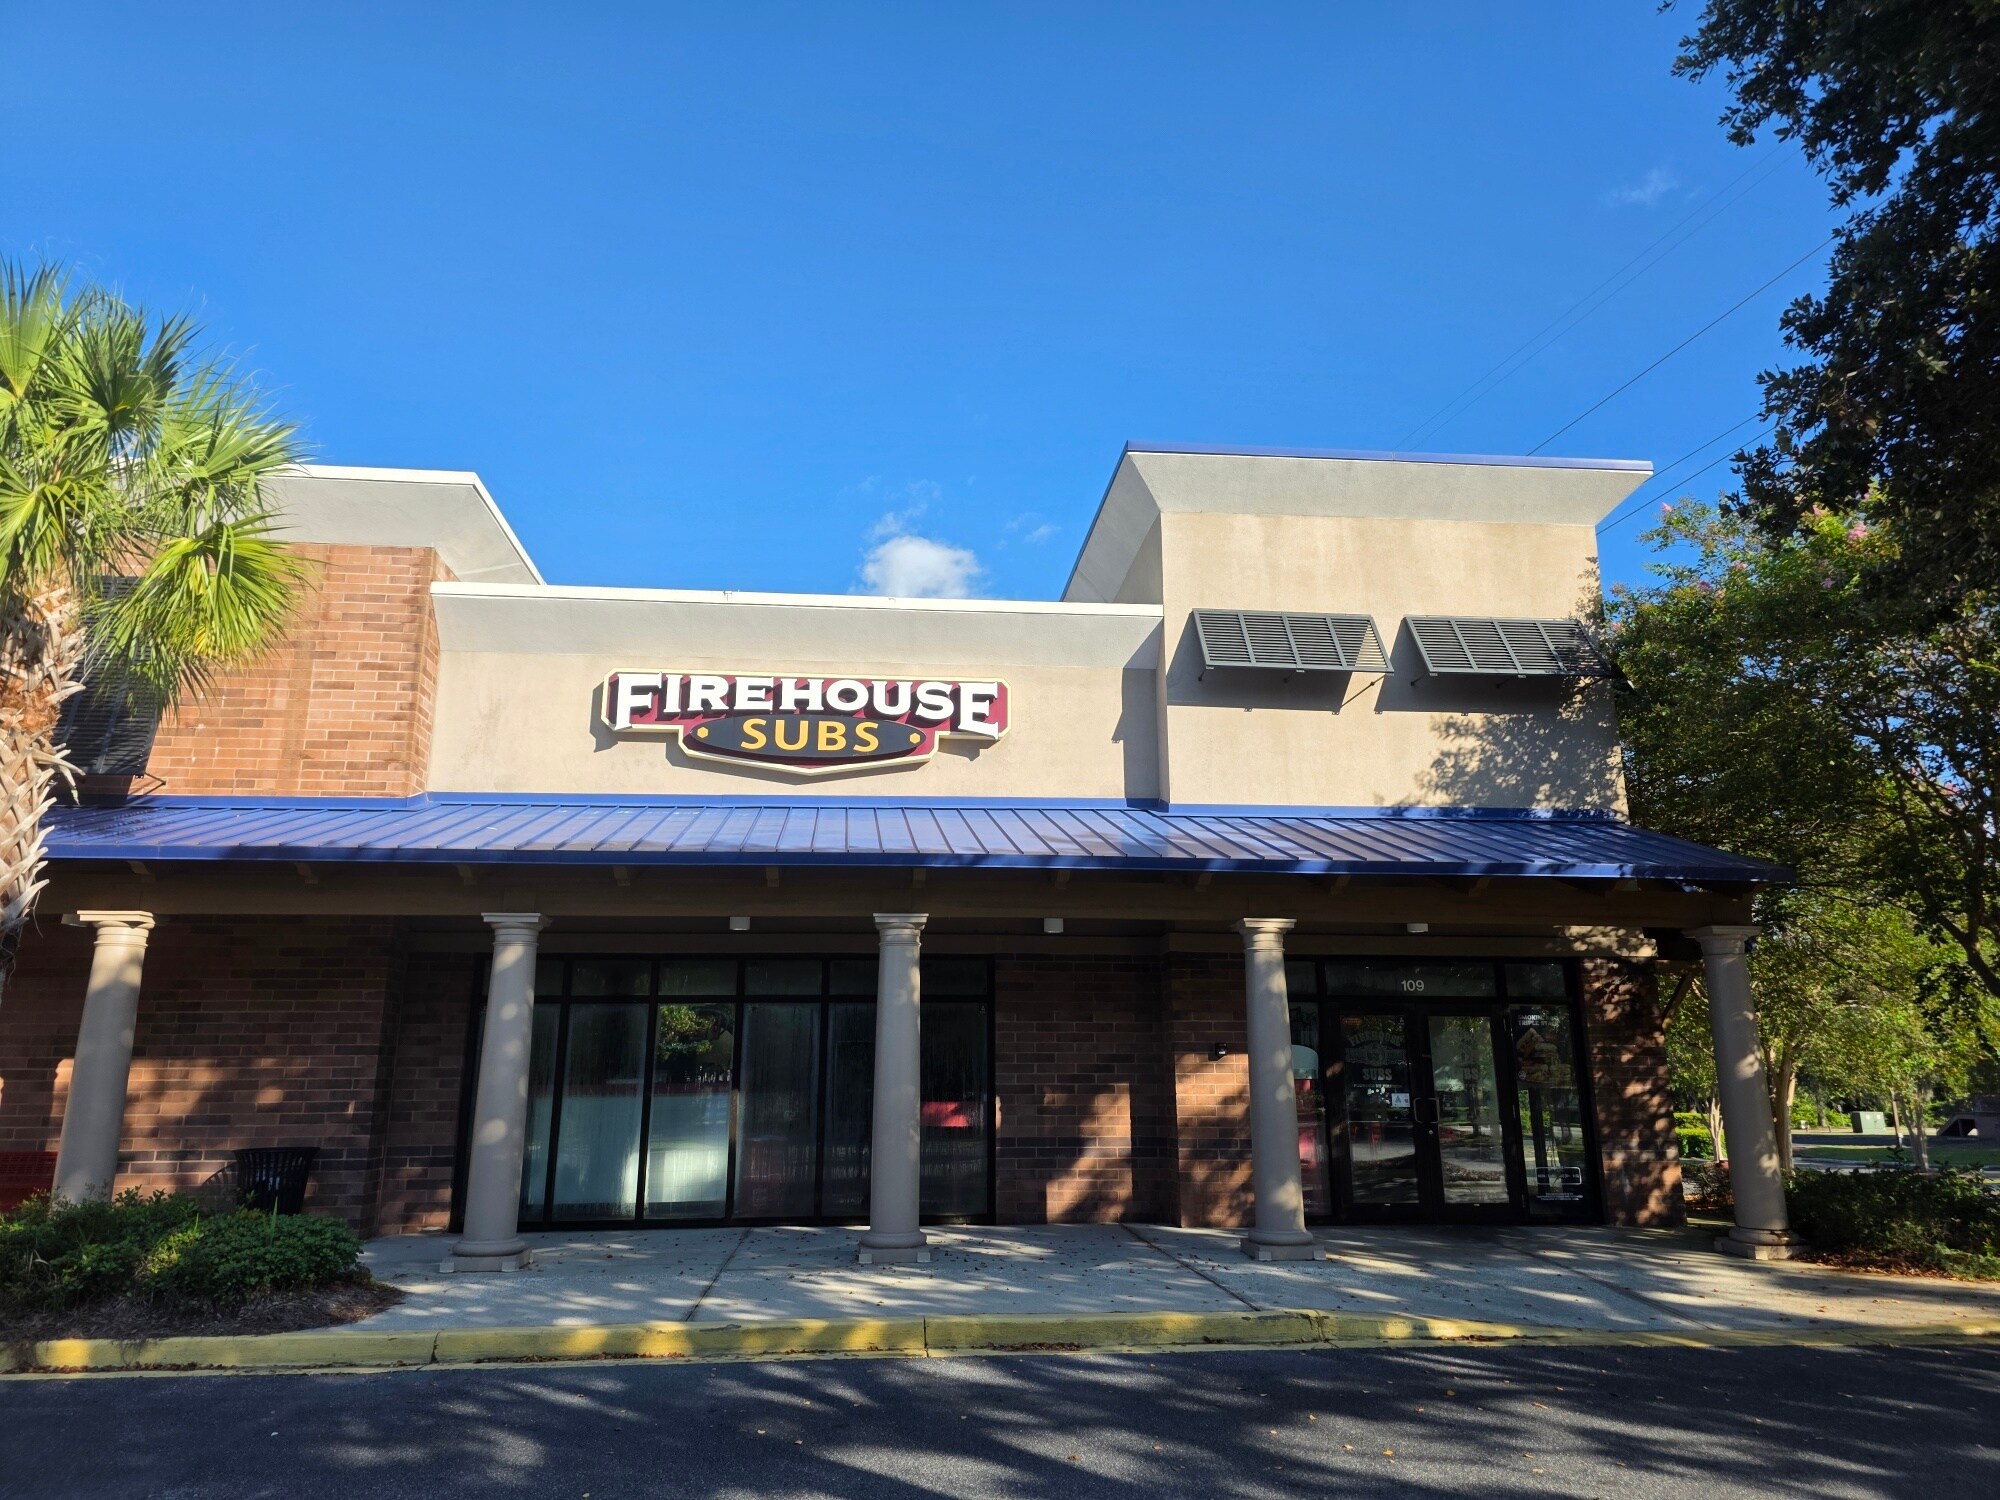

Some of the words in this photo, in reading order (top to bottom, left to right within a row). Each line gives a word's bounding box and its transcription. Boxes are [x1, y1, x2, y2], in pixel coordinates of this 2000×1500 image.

[614, 672, 1000, 740] FIREHOUSE
[740, 718, 879, 753] SUBS
[1400, 979, 1425, 992] 109
[1362, 1067, 1393, 1081] SUBS
